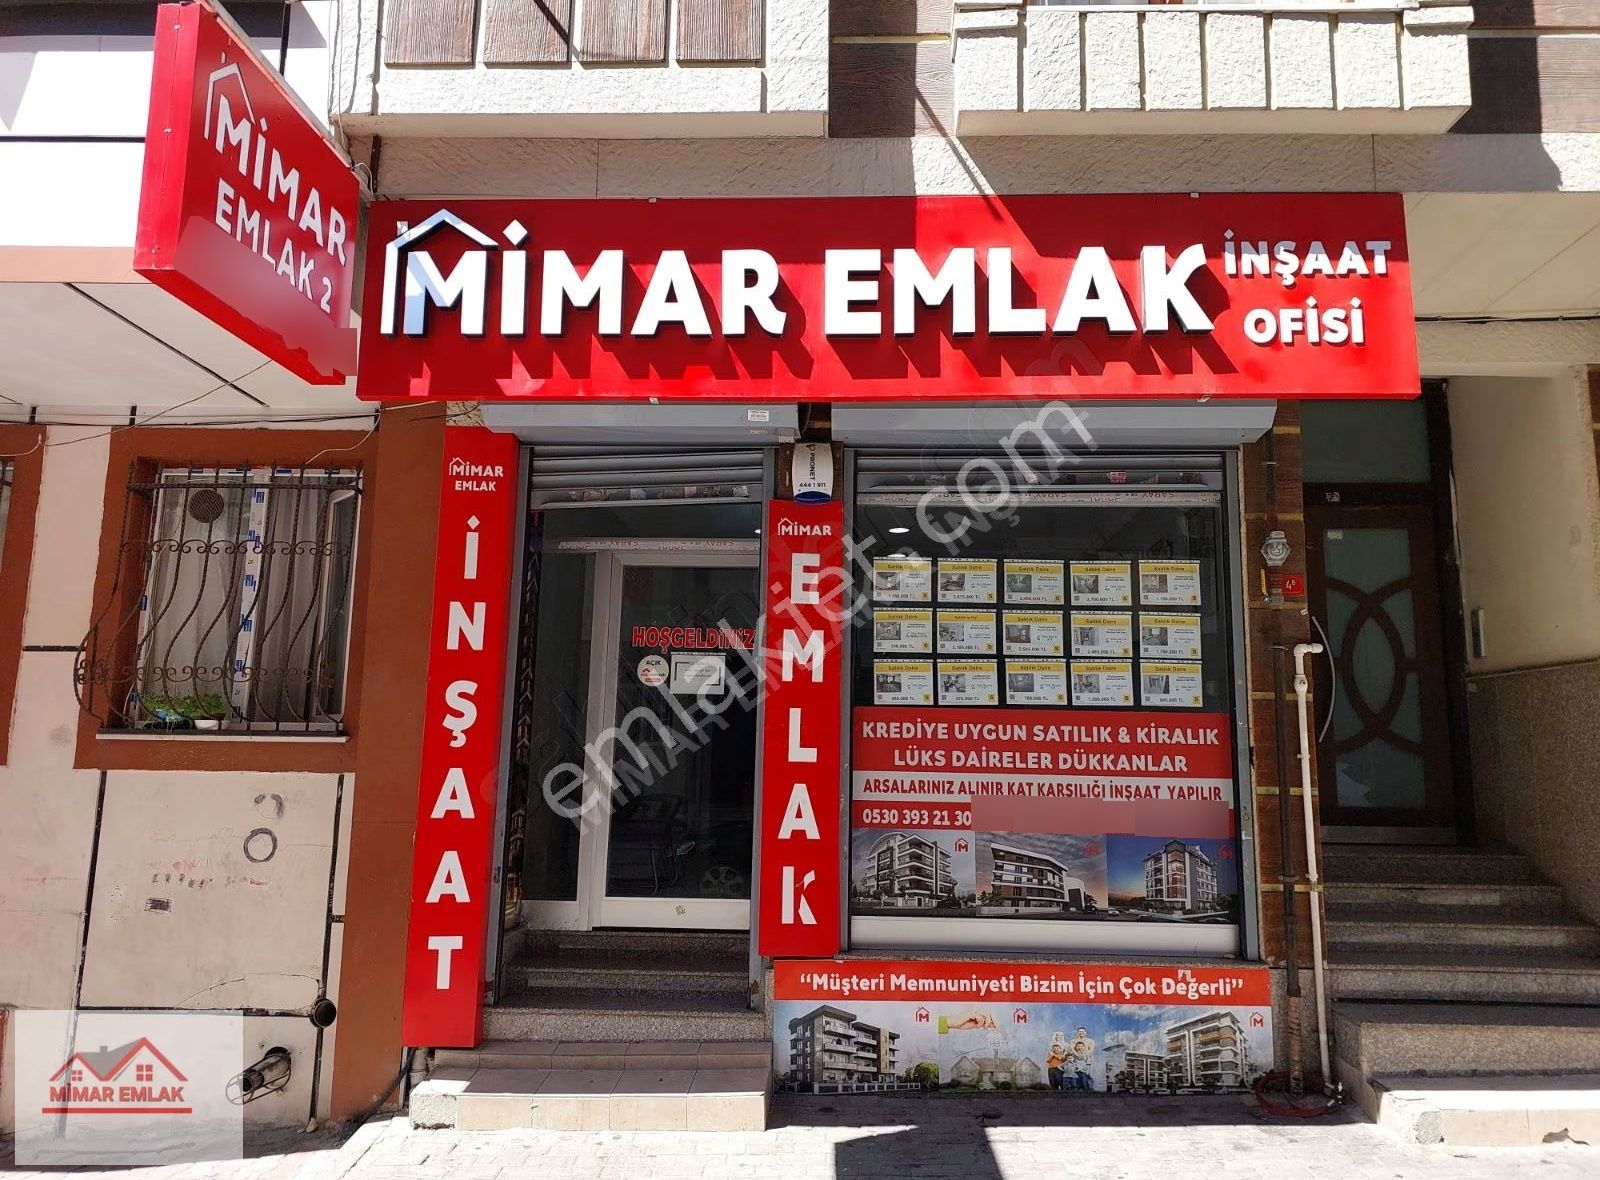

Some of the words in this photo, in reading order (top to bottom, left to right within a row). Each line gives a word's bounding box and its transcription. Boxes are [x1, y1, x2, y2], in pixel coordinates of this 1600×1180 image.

[215, 94, 346, 266] MİMAR
[215, 177, 316, 302] EMLAK
[320, 276, 333, 314] 2
[1224, 229, 1392, 286] İNŞAAT
[403, 218, 787, 337] MİMAR
[825, 243, 1215, 337] EMLAK
[1243, 296, 1366, 346] OFİSİ
[453, 461, 504, 477] MİMAR
[455, 480, 496, 491] EMLAK
[781, 521, 832, 536] MİMAR
[631, 625, 756, 654] HOŞGELDİNİZ
[777, 552, 825, 925] EMLAK
[863, 718, 949, 739] KREDİYE
[954, 723, 1027, 741] UYGUN
[1033, 725, 1112, 743] SATILIK
[1118, 726, 1131, 743] &
[1136, 722, 1219, 745] KİRALIK
[426, 515, 486, 990] İNŞAAT
[894, 745, 946, 767] LÜKS
[952, 746, 1053, 770] DAİRELER
[1058, 749, 1188, 772] DÜKKANLAR
[863, 778, 955, 795] ARSALARINIZ
[958, 780, 1004, 796] ALINIR
[1007, 782, 1034, 796] KAT
[1110, 780, 1161, 802] İNŞAAT
[1167, 785, 1222, 801] YAPILIR
[862, 808, 899, 824] 0530
[902, 810, 929, 825] 393
[932, 810, 950, 826] 21
[954, 810, 971, 826] 30
[890, 974, 1015, 996] Memnuniyeti
[1020, 975, 1074, 993] Bizim
[1078, 971, 1115, 998] İçin
[1118, 976, 1157, 999] Çok
